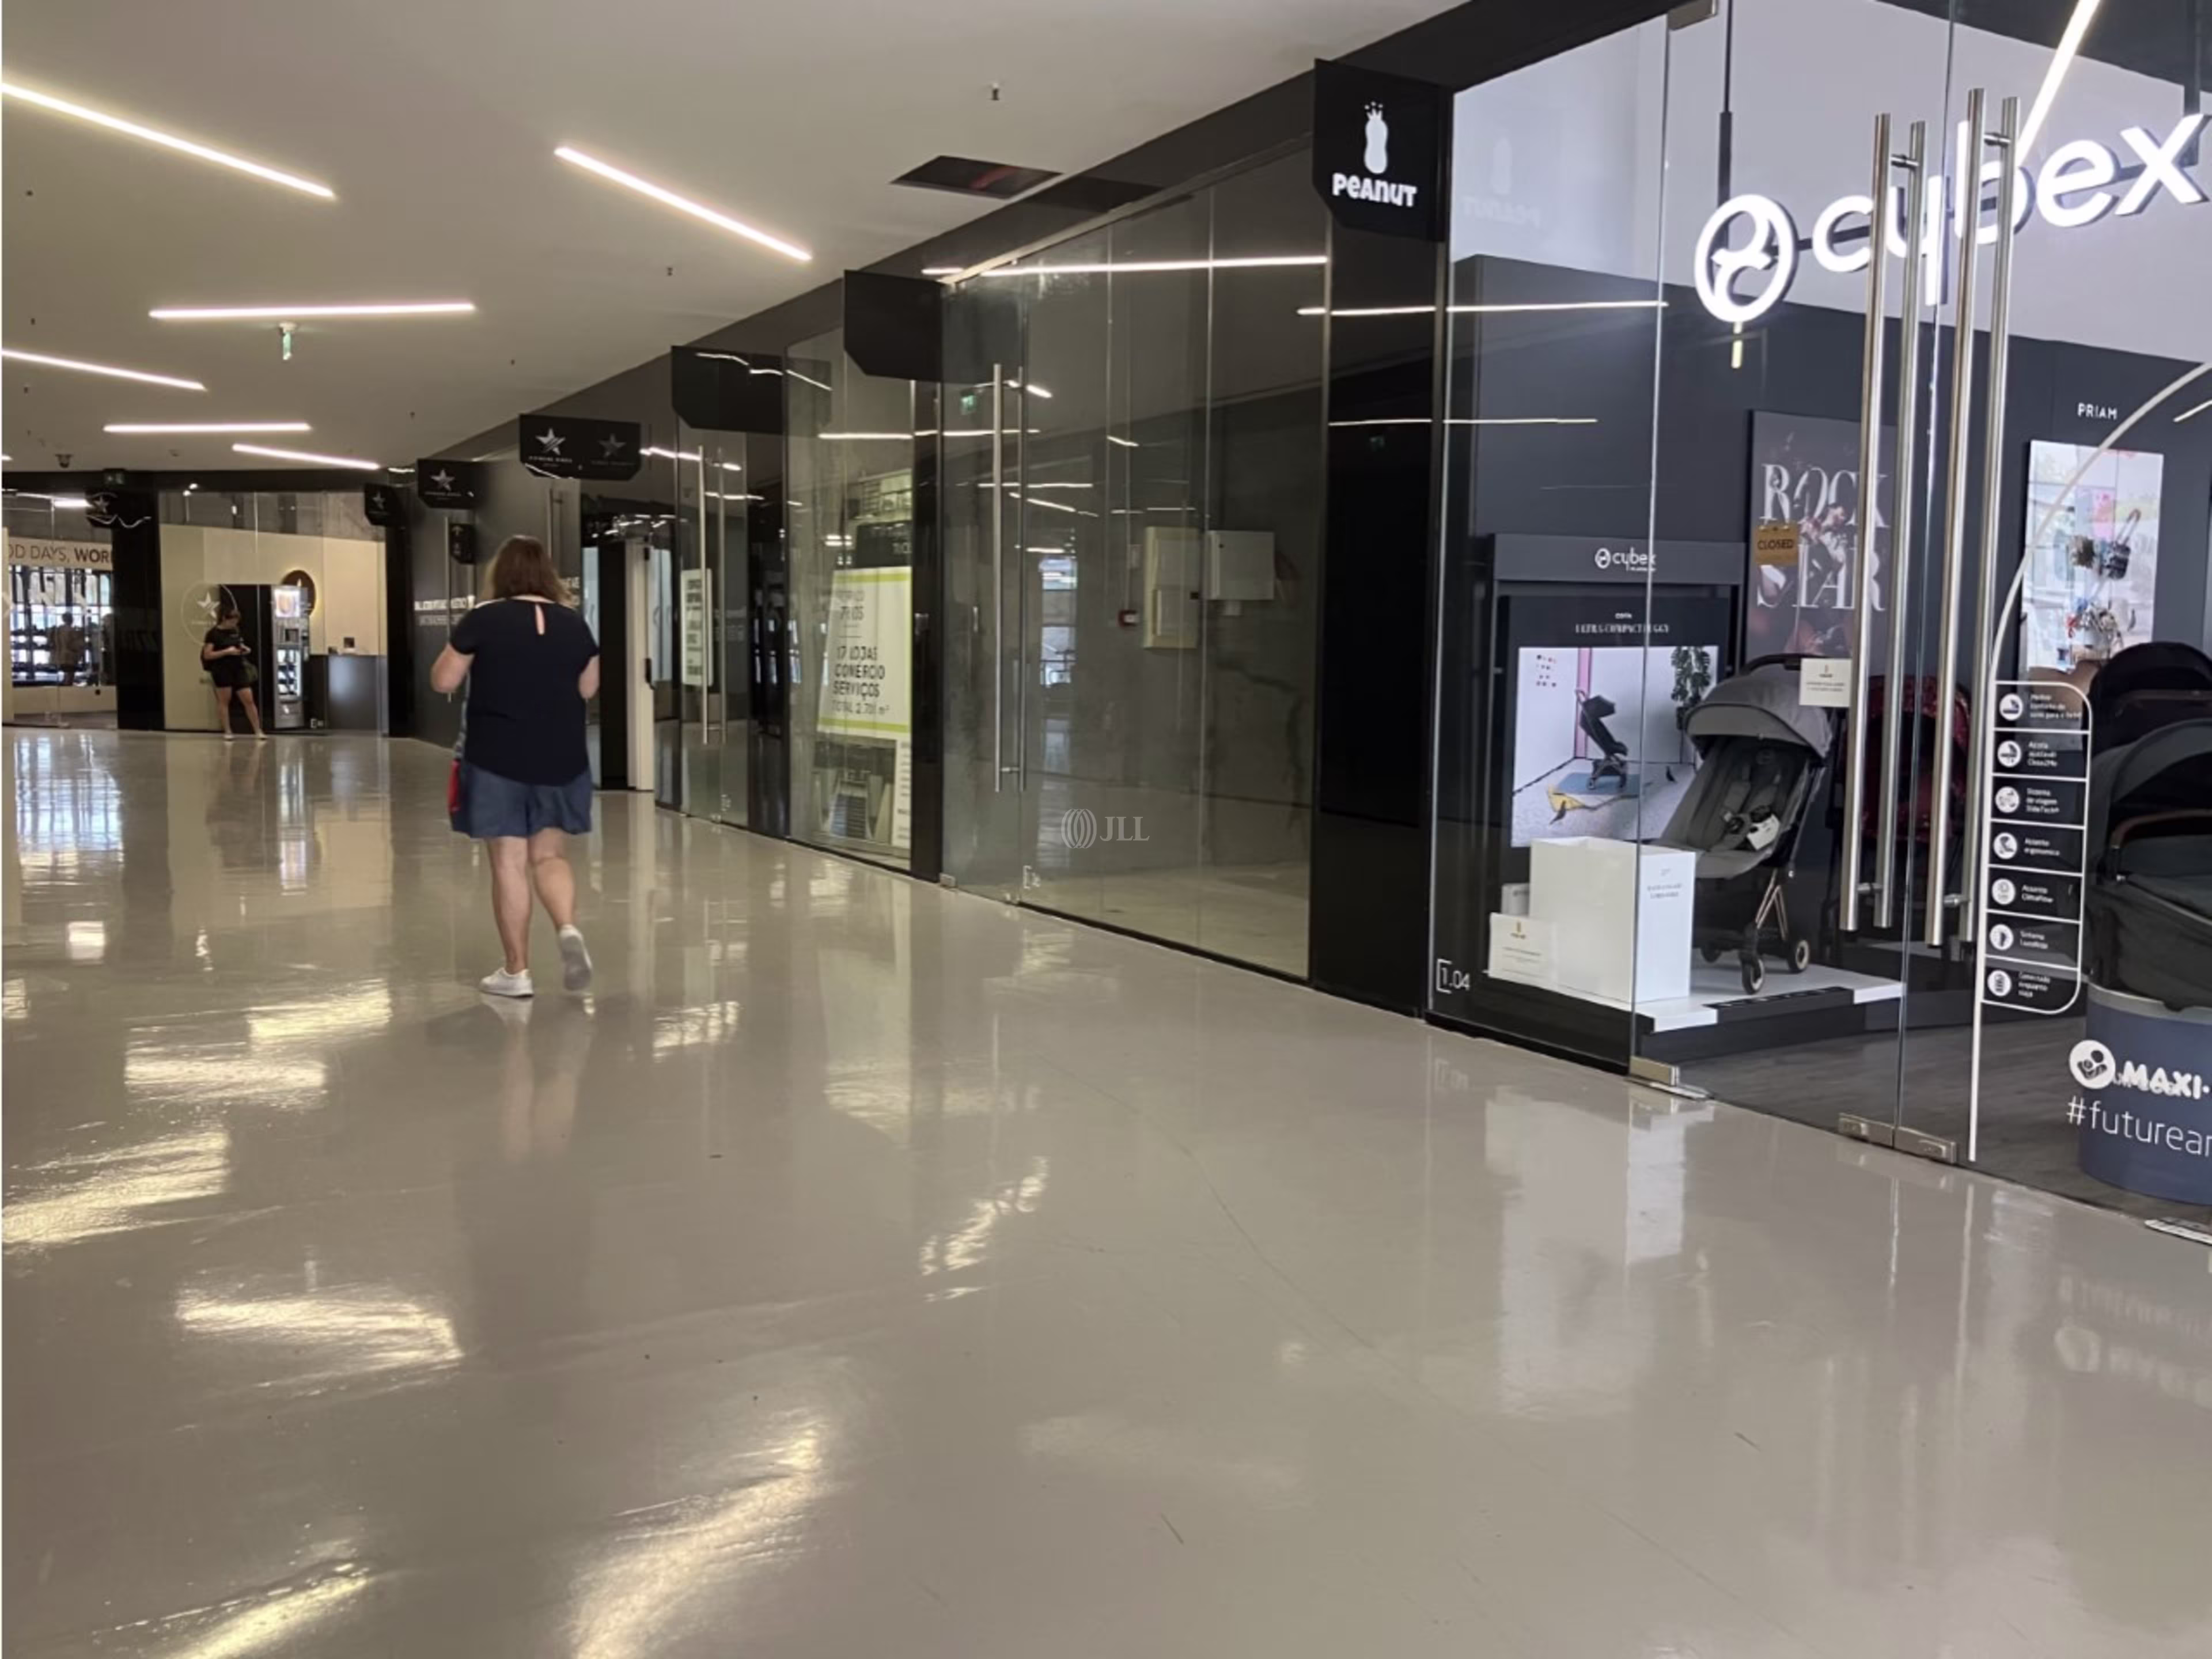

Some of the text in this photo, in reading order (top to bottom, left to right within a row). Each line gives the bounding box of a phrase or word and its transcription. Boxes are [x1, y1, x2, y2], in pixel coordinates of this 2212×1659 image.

[1812, 113, 2210, 306] cybex
[2077, 402, 2118, 420] PRIAM
[1758, 539, 1794, 551] CLOSED
[31, 546, 70, 563] DAYS,
[75, 548, 112, 564] WOR
[1612, 547, 1657, 571] cybex
